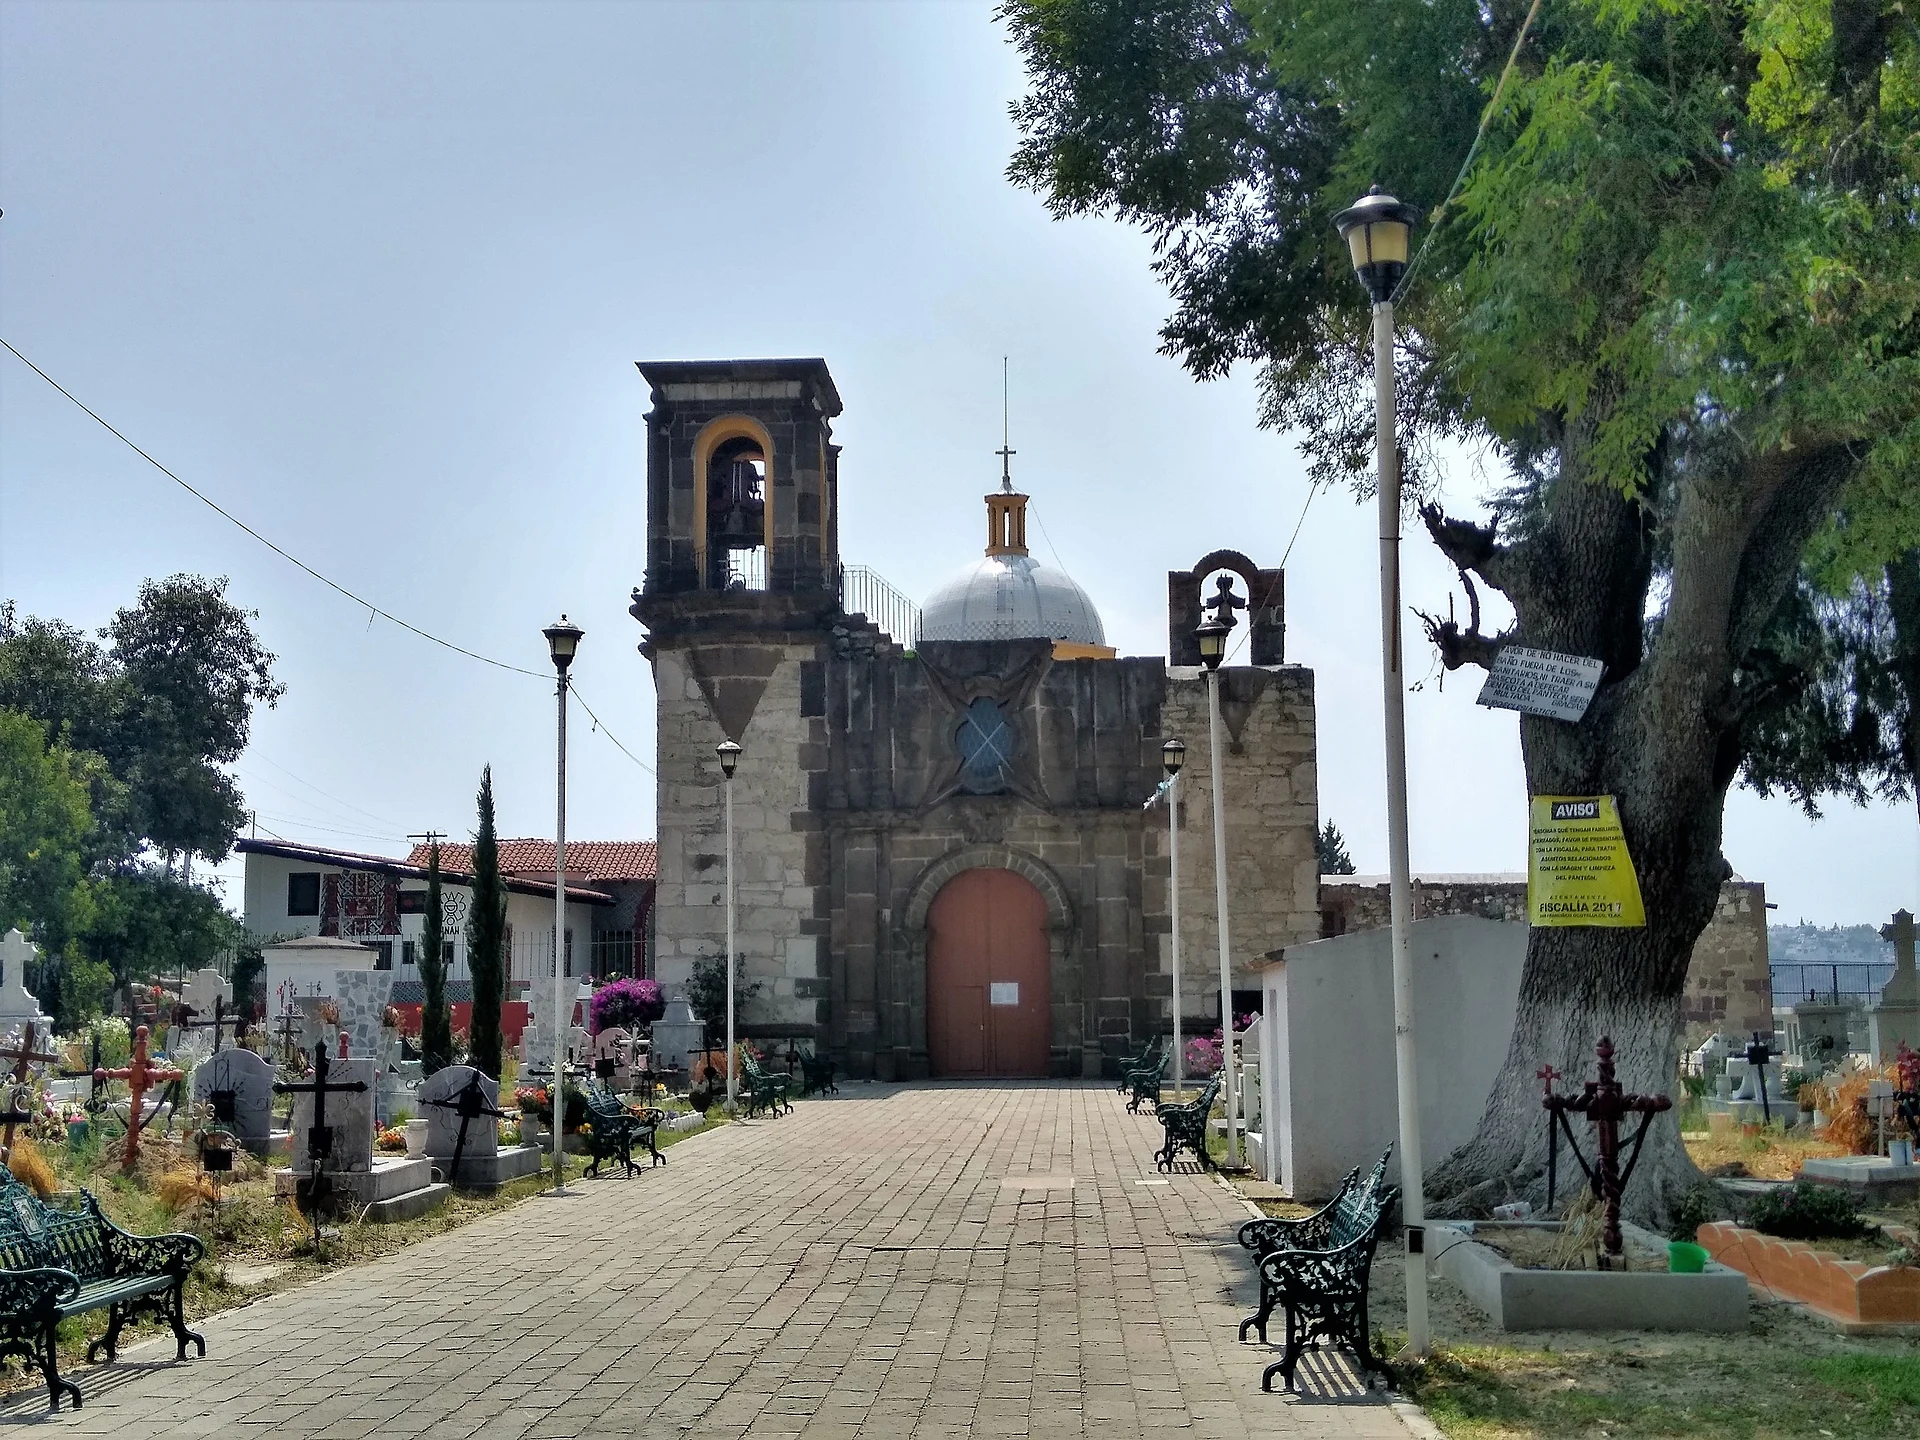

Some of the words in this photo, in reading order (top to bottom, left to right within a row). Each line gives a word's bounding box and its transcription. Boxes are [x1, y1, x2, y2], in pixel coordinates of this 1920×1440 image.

[1501, 645, 1523, 655] FAVOR
[1526, 649, 1536, 657] DE
[1553, 653, 1579, 665] HACER
[1582, 658, 1597, 668] DEL
[1520, 660, 1544, 670] FUERA
[1546, 664, 1557, 672] DE
[1560, 666, 1577, 677] LOS
[1551, 675, 1575, 687] TRAER
[1584, 681, 1596, 690] SU
[1556, 803, 1594, 817] AVISO
[1539, 900, 1589, 912] FISCALÍA
